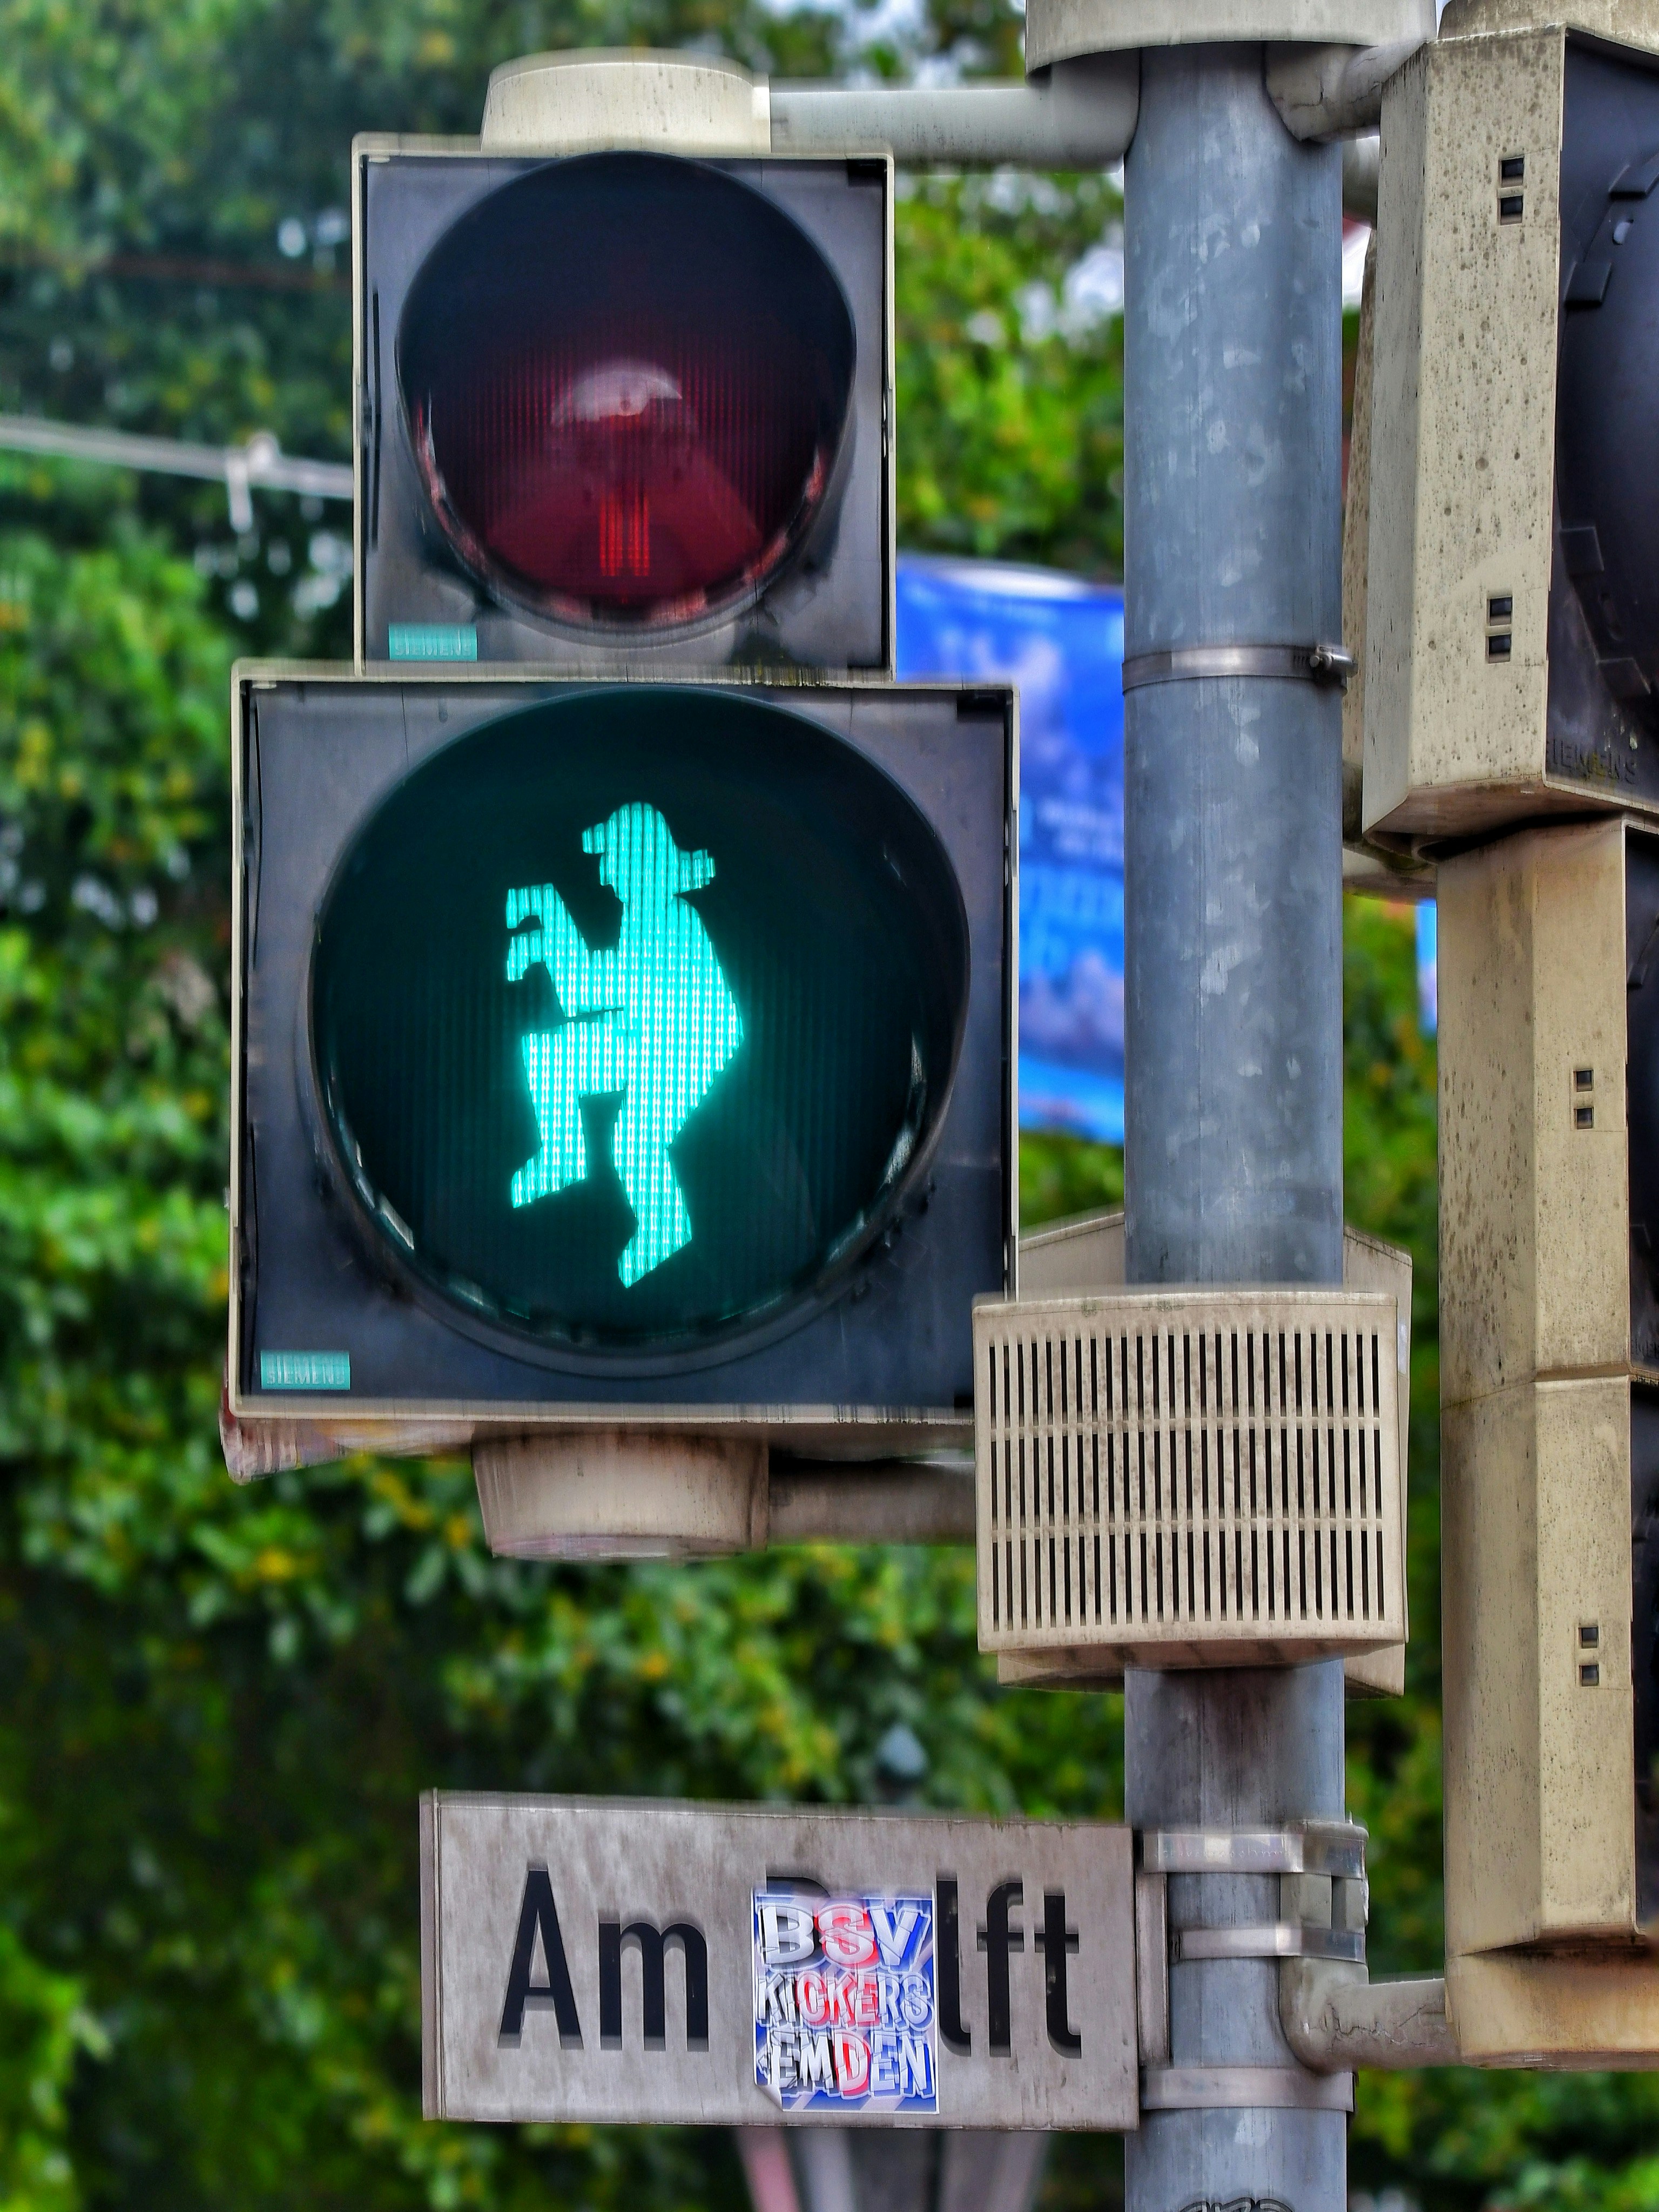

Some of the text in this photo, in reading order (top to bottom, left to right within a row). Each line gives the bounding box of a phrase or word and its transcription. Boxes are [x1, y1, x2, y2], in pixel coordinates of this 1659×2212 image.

[394, 637, 471, 656] SIEMENS
[1547, 738, 1636, 785] IEMENS
[267, 1364, 345, 1385] SIEMENS
[498, 1863, 709, 2051] Am
[758, 1903, 930, 1970] BSV
[757, 1970, 933, 2029] KICKERS
[763, 2031, 933, 2096] EMDEN
